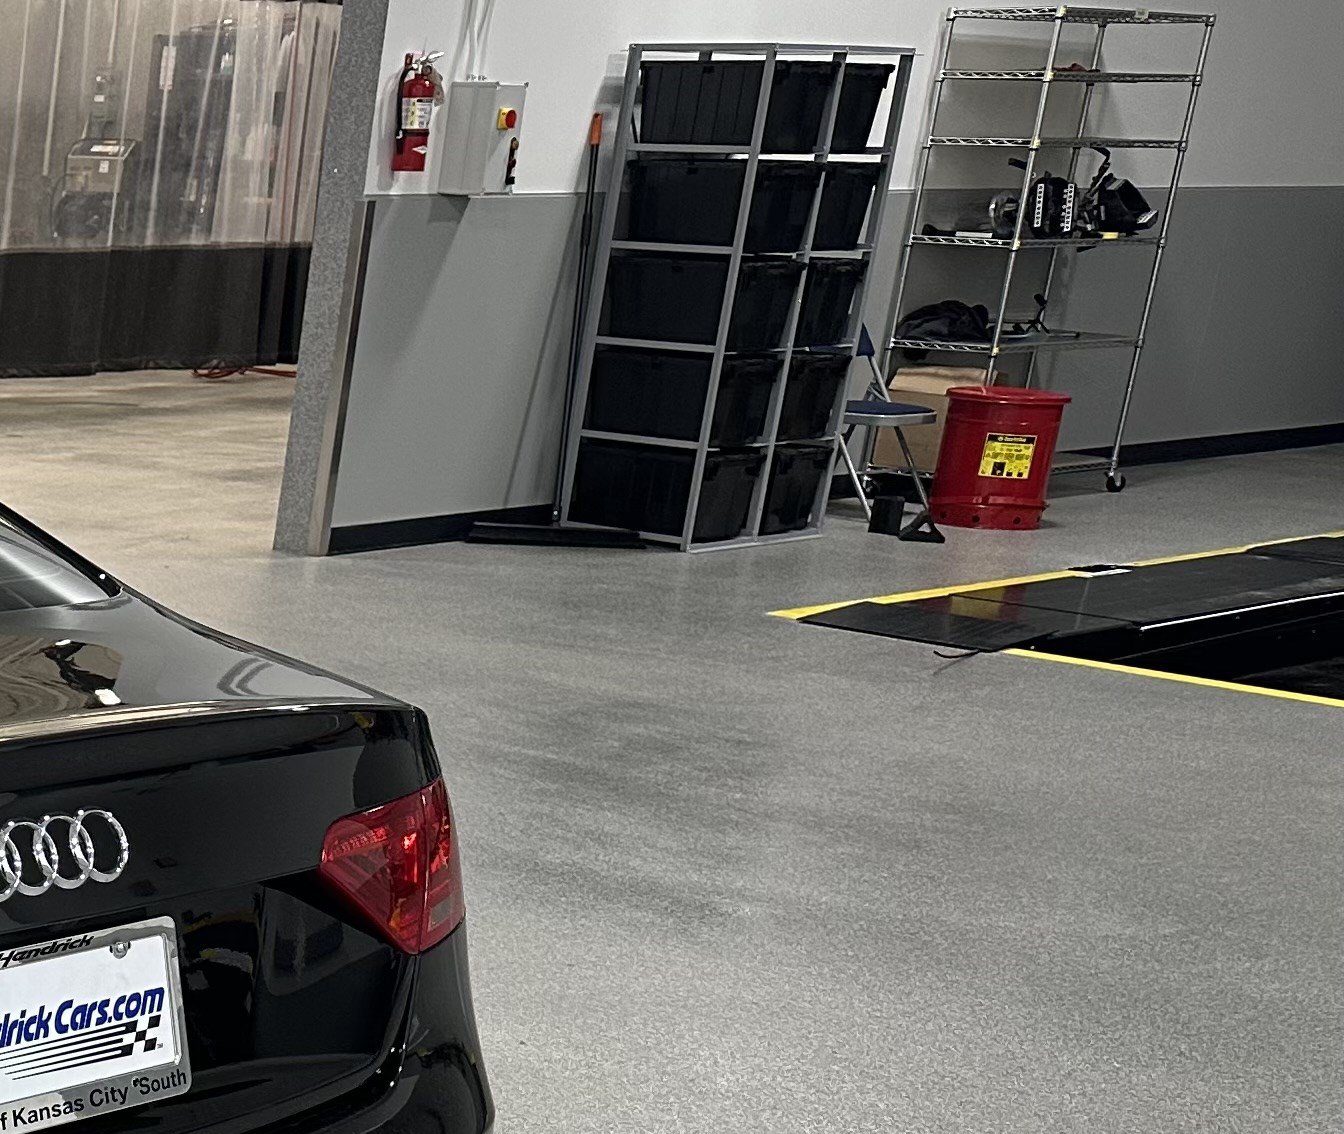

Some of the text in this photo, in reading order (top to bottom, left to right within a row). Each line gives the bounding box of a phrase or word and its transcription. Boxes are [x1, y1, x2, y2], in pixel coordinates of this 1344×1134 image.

[12, 1098, 85, 1128] Kansas
[89, 1084, 129, 1110] City
[139, 1068, 188, 1095] South
